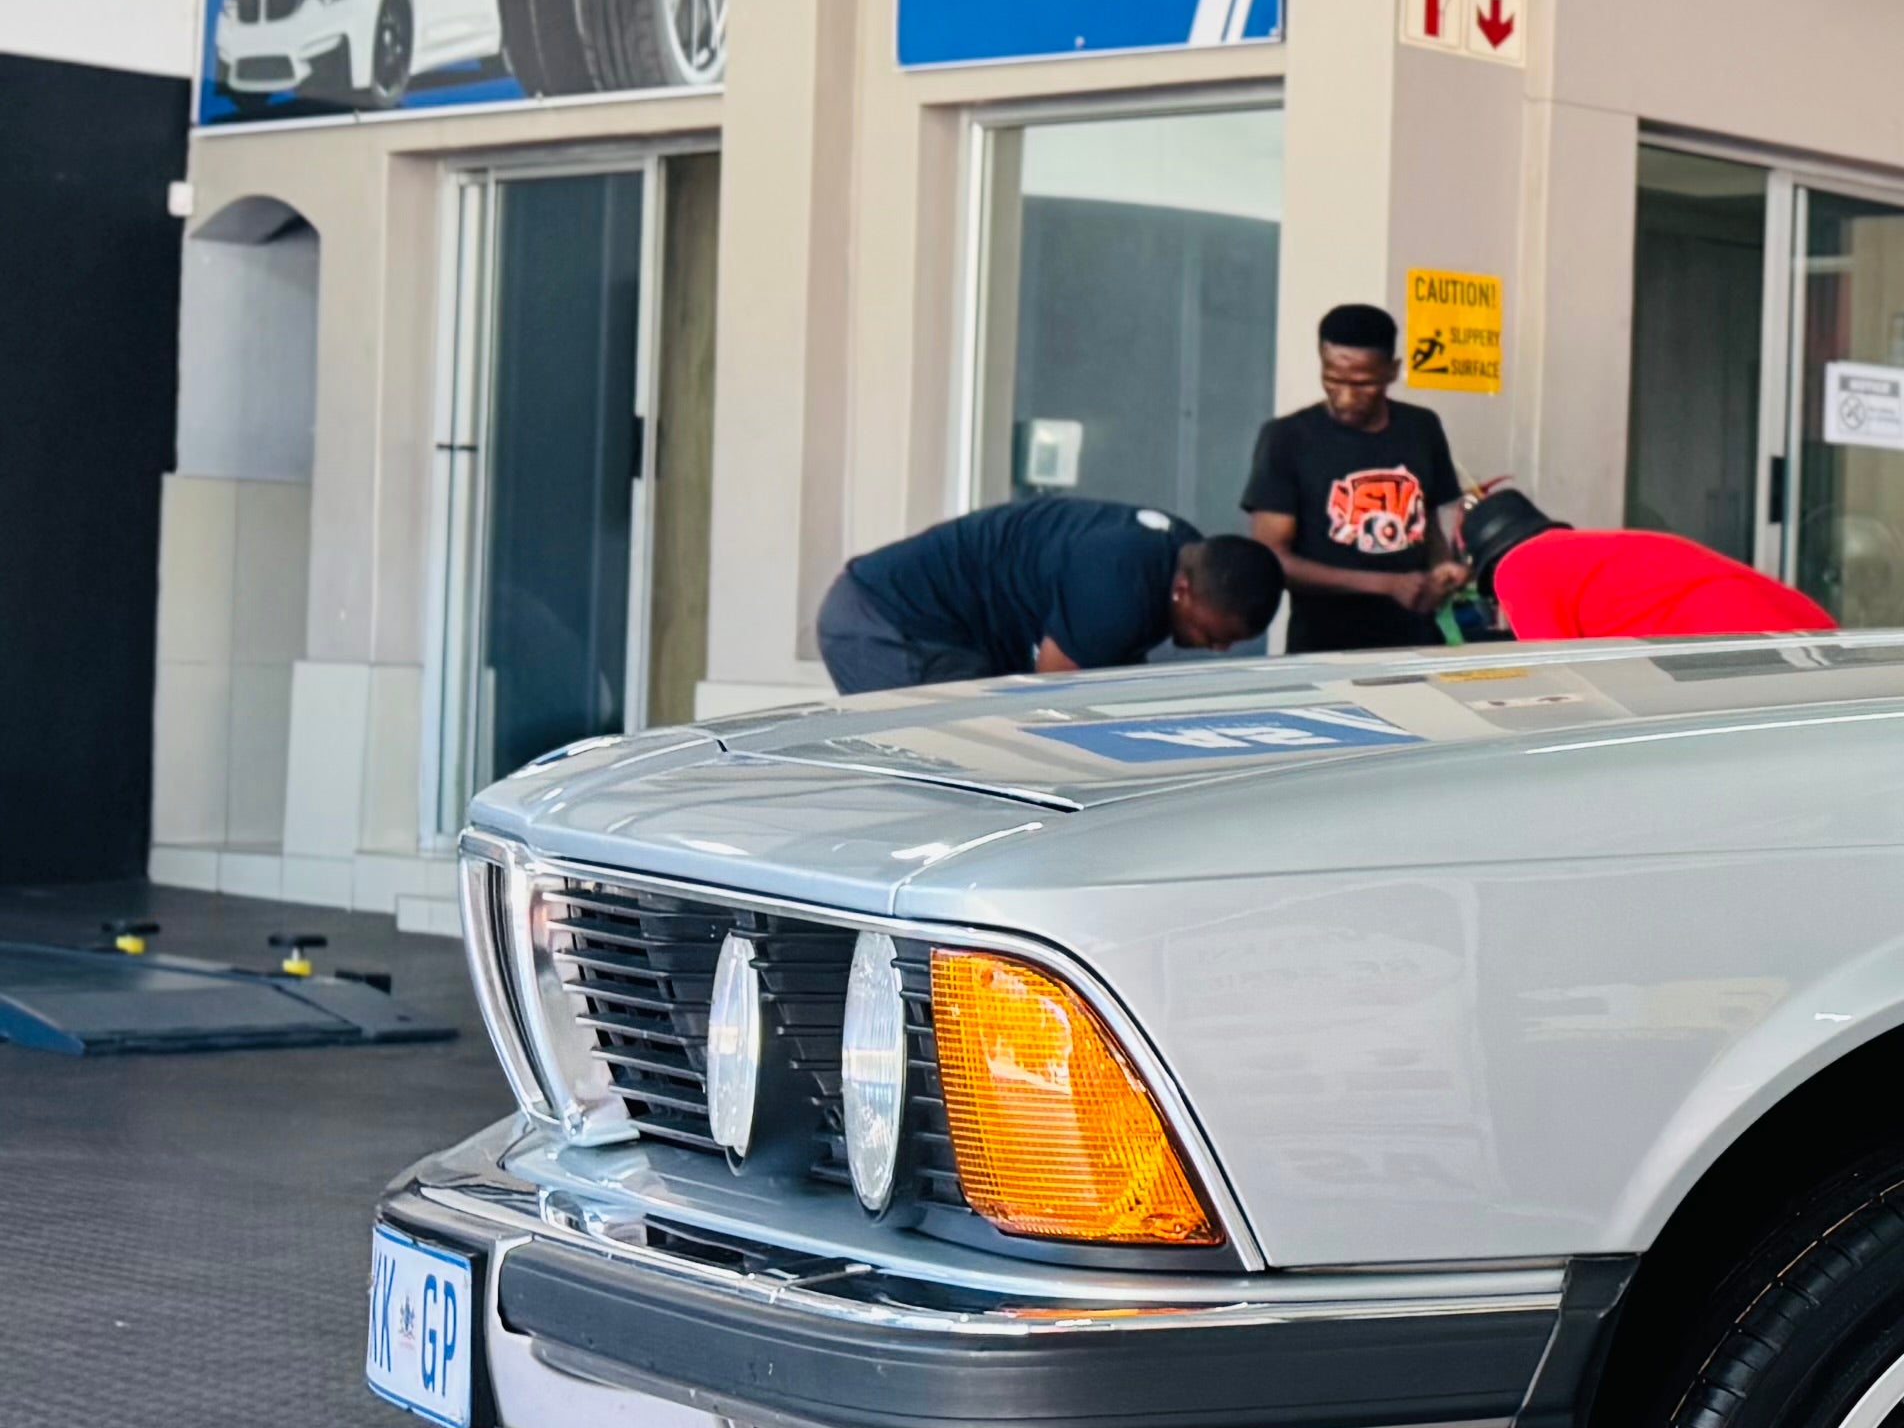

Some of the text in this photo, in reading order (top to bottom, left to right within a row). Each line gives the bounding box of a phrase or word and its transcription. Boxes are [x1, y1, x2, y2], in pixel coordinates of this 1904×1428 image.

[1415, 275, 1497, 310] CAUTION!
[1450, 326, 1500, 348] SLIPPERY
[1450, 357, 1500, 380] SURFACE
[421, 1272, 458, 1398] GP
